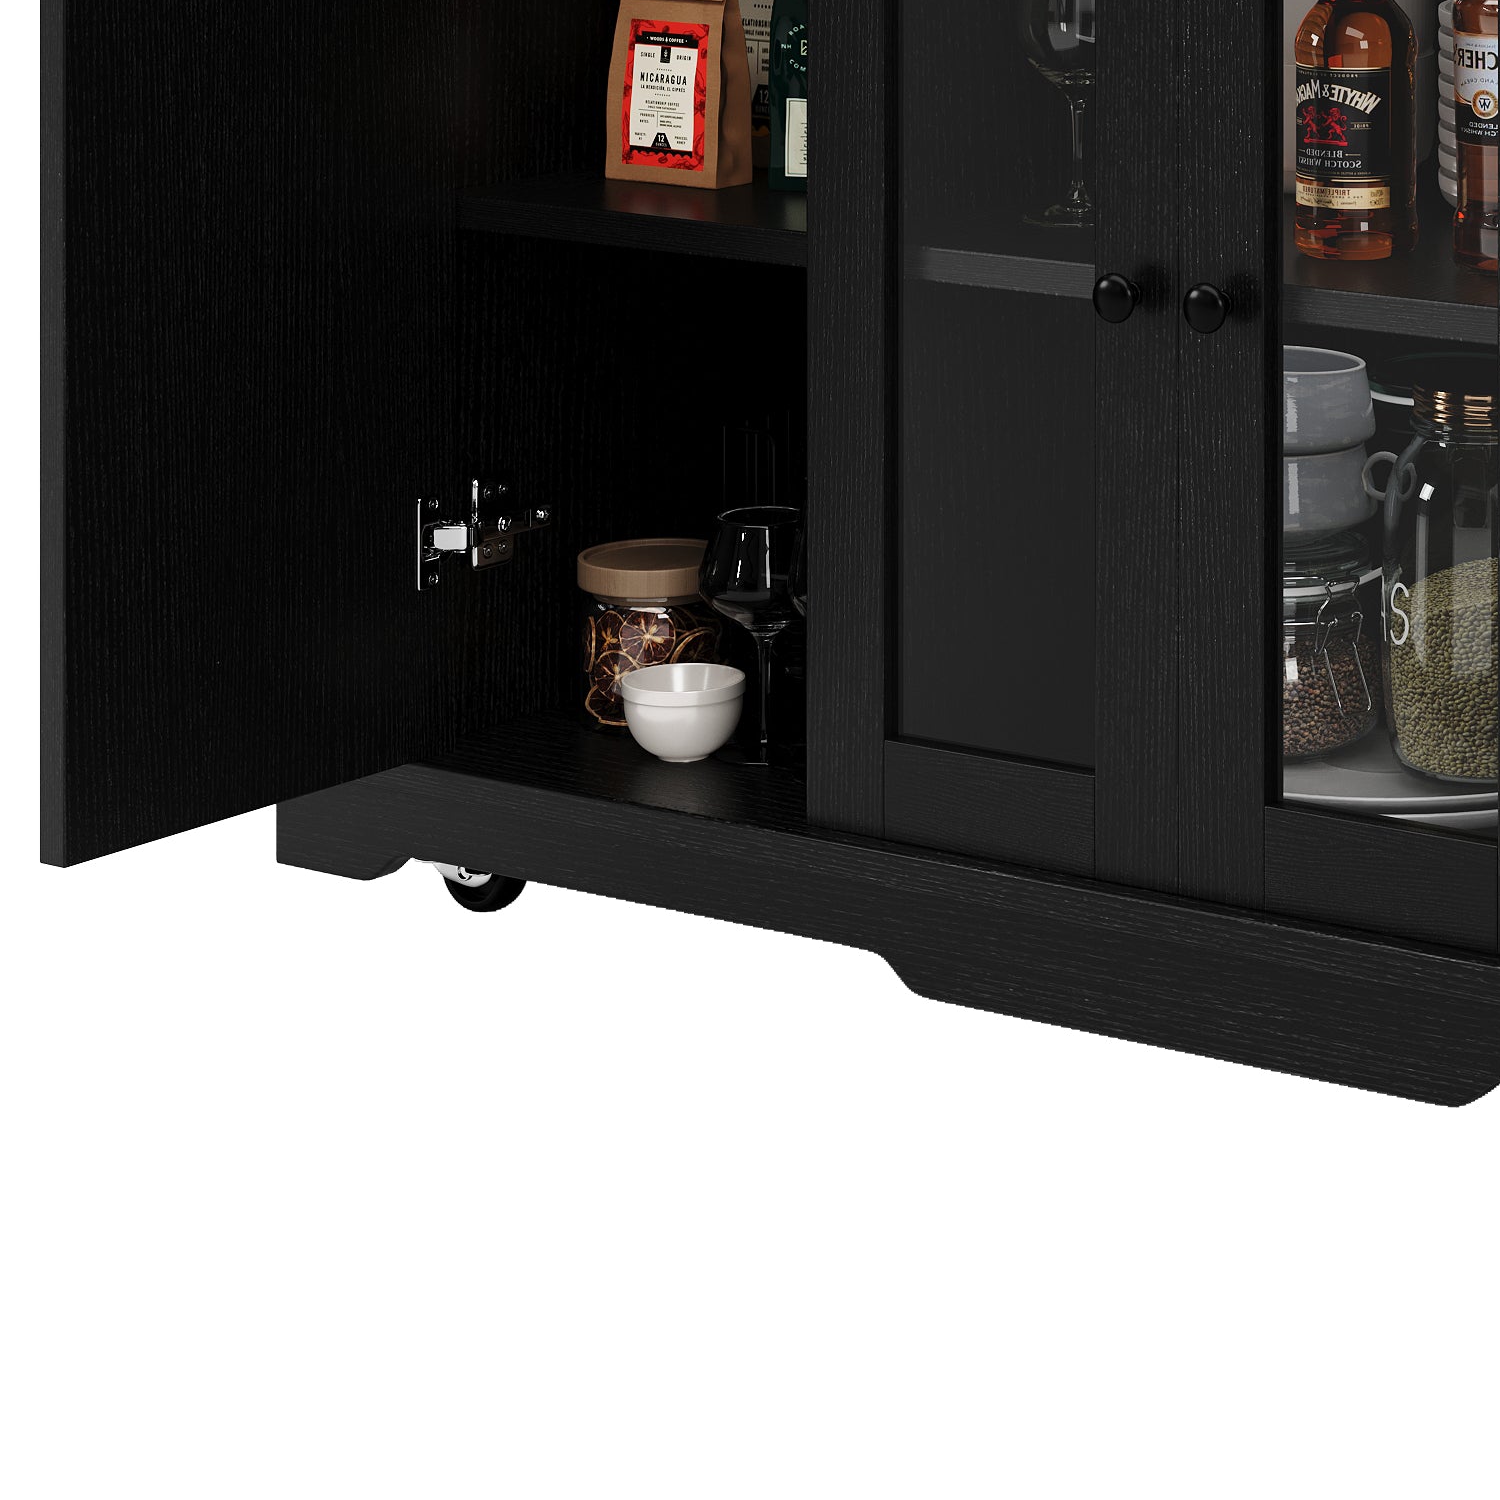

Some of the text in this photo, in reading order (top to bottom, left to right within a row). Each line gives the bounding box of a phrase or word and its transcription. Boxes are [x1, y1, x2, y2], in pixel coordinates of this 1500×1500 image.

[640, 51, 656, 59] SINGLE
[640, 71, 687, 86] NICARAGUA
[657, 134, 665, 143] 12
